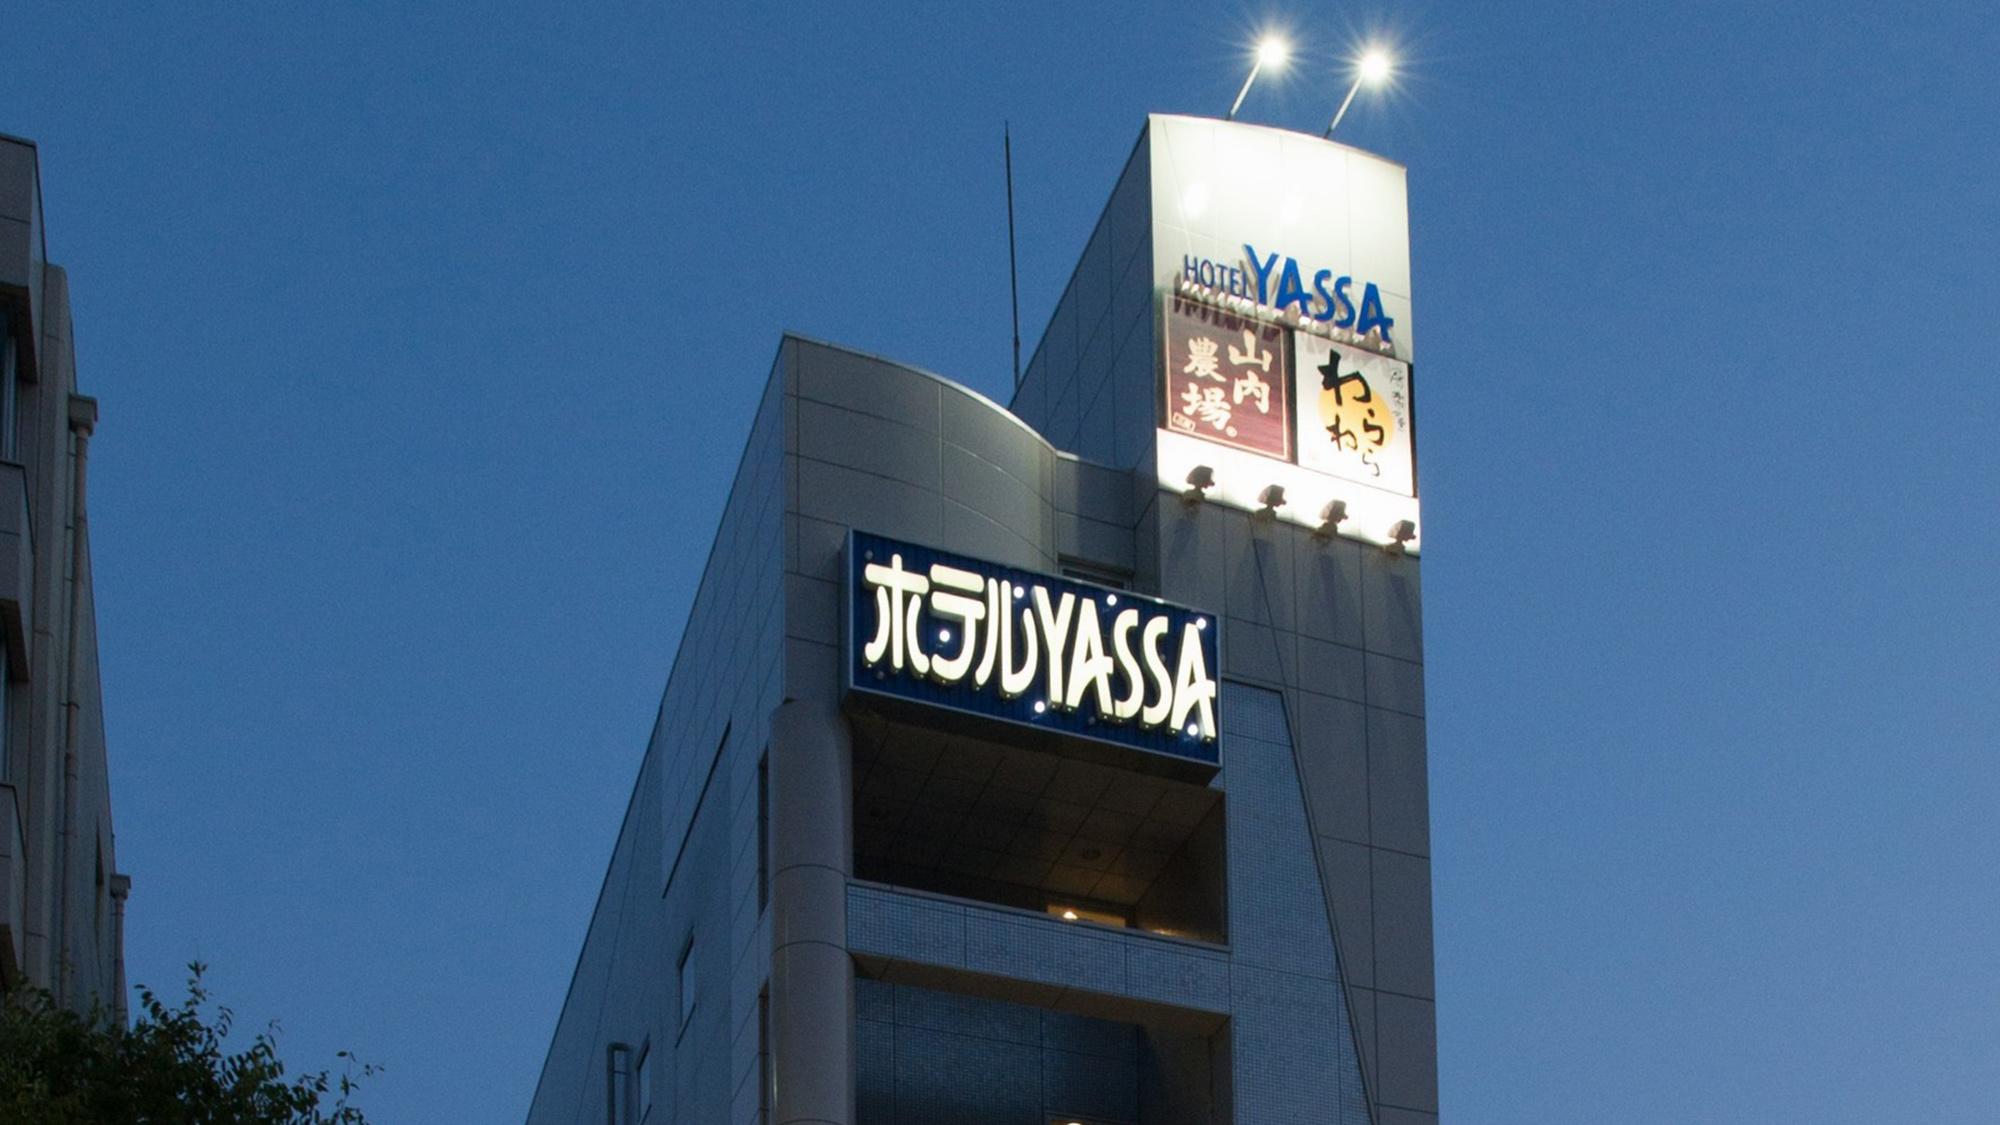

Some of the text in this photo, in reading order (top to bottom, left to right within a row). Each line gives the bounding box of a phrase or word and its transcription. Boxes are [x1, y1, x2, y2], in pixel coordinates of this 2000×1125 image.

[1183, 244, 1394, 342] HOTEL YASSA
[1228, 329, 1273, 414] 山内
